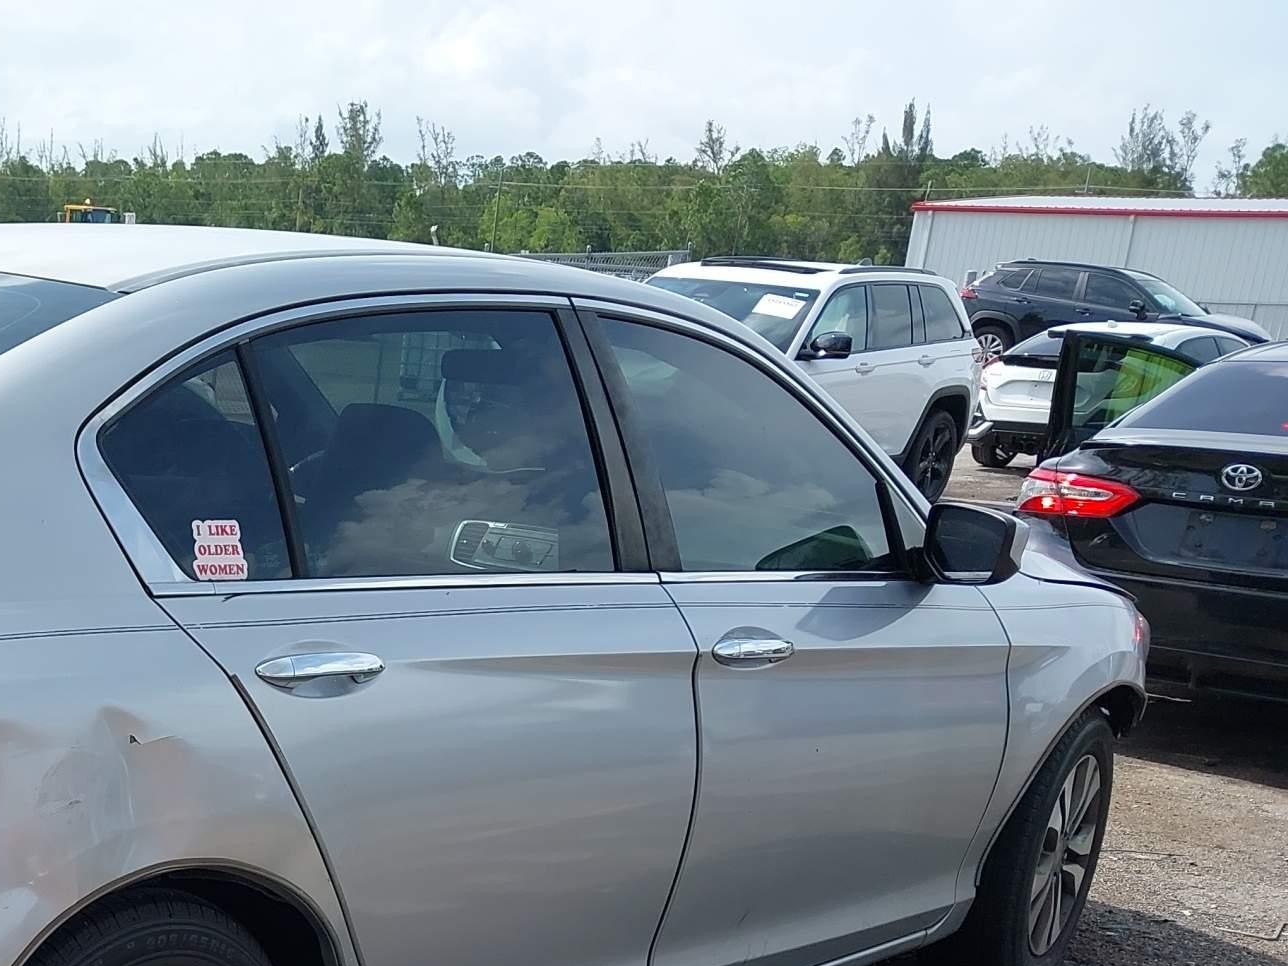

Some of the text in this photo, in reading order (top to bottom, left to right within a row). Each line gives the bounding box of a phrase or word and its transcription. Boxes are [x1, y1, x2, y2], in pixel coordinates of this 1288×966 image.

[196, 525, 238, 536] I LIKE
[198, 544, 240, 556] OLDER
[197, 564, 245, 576] WOMEN
